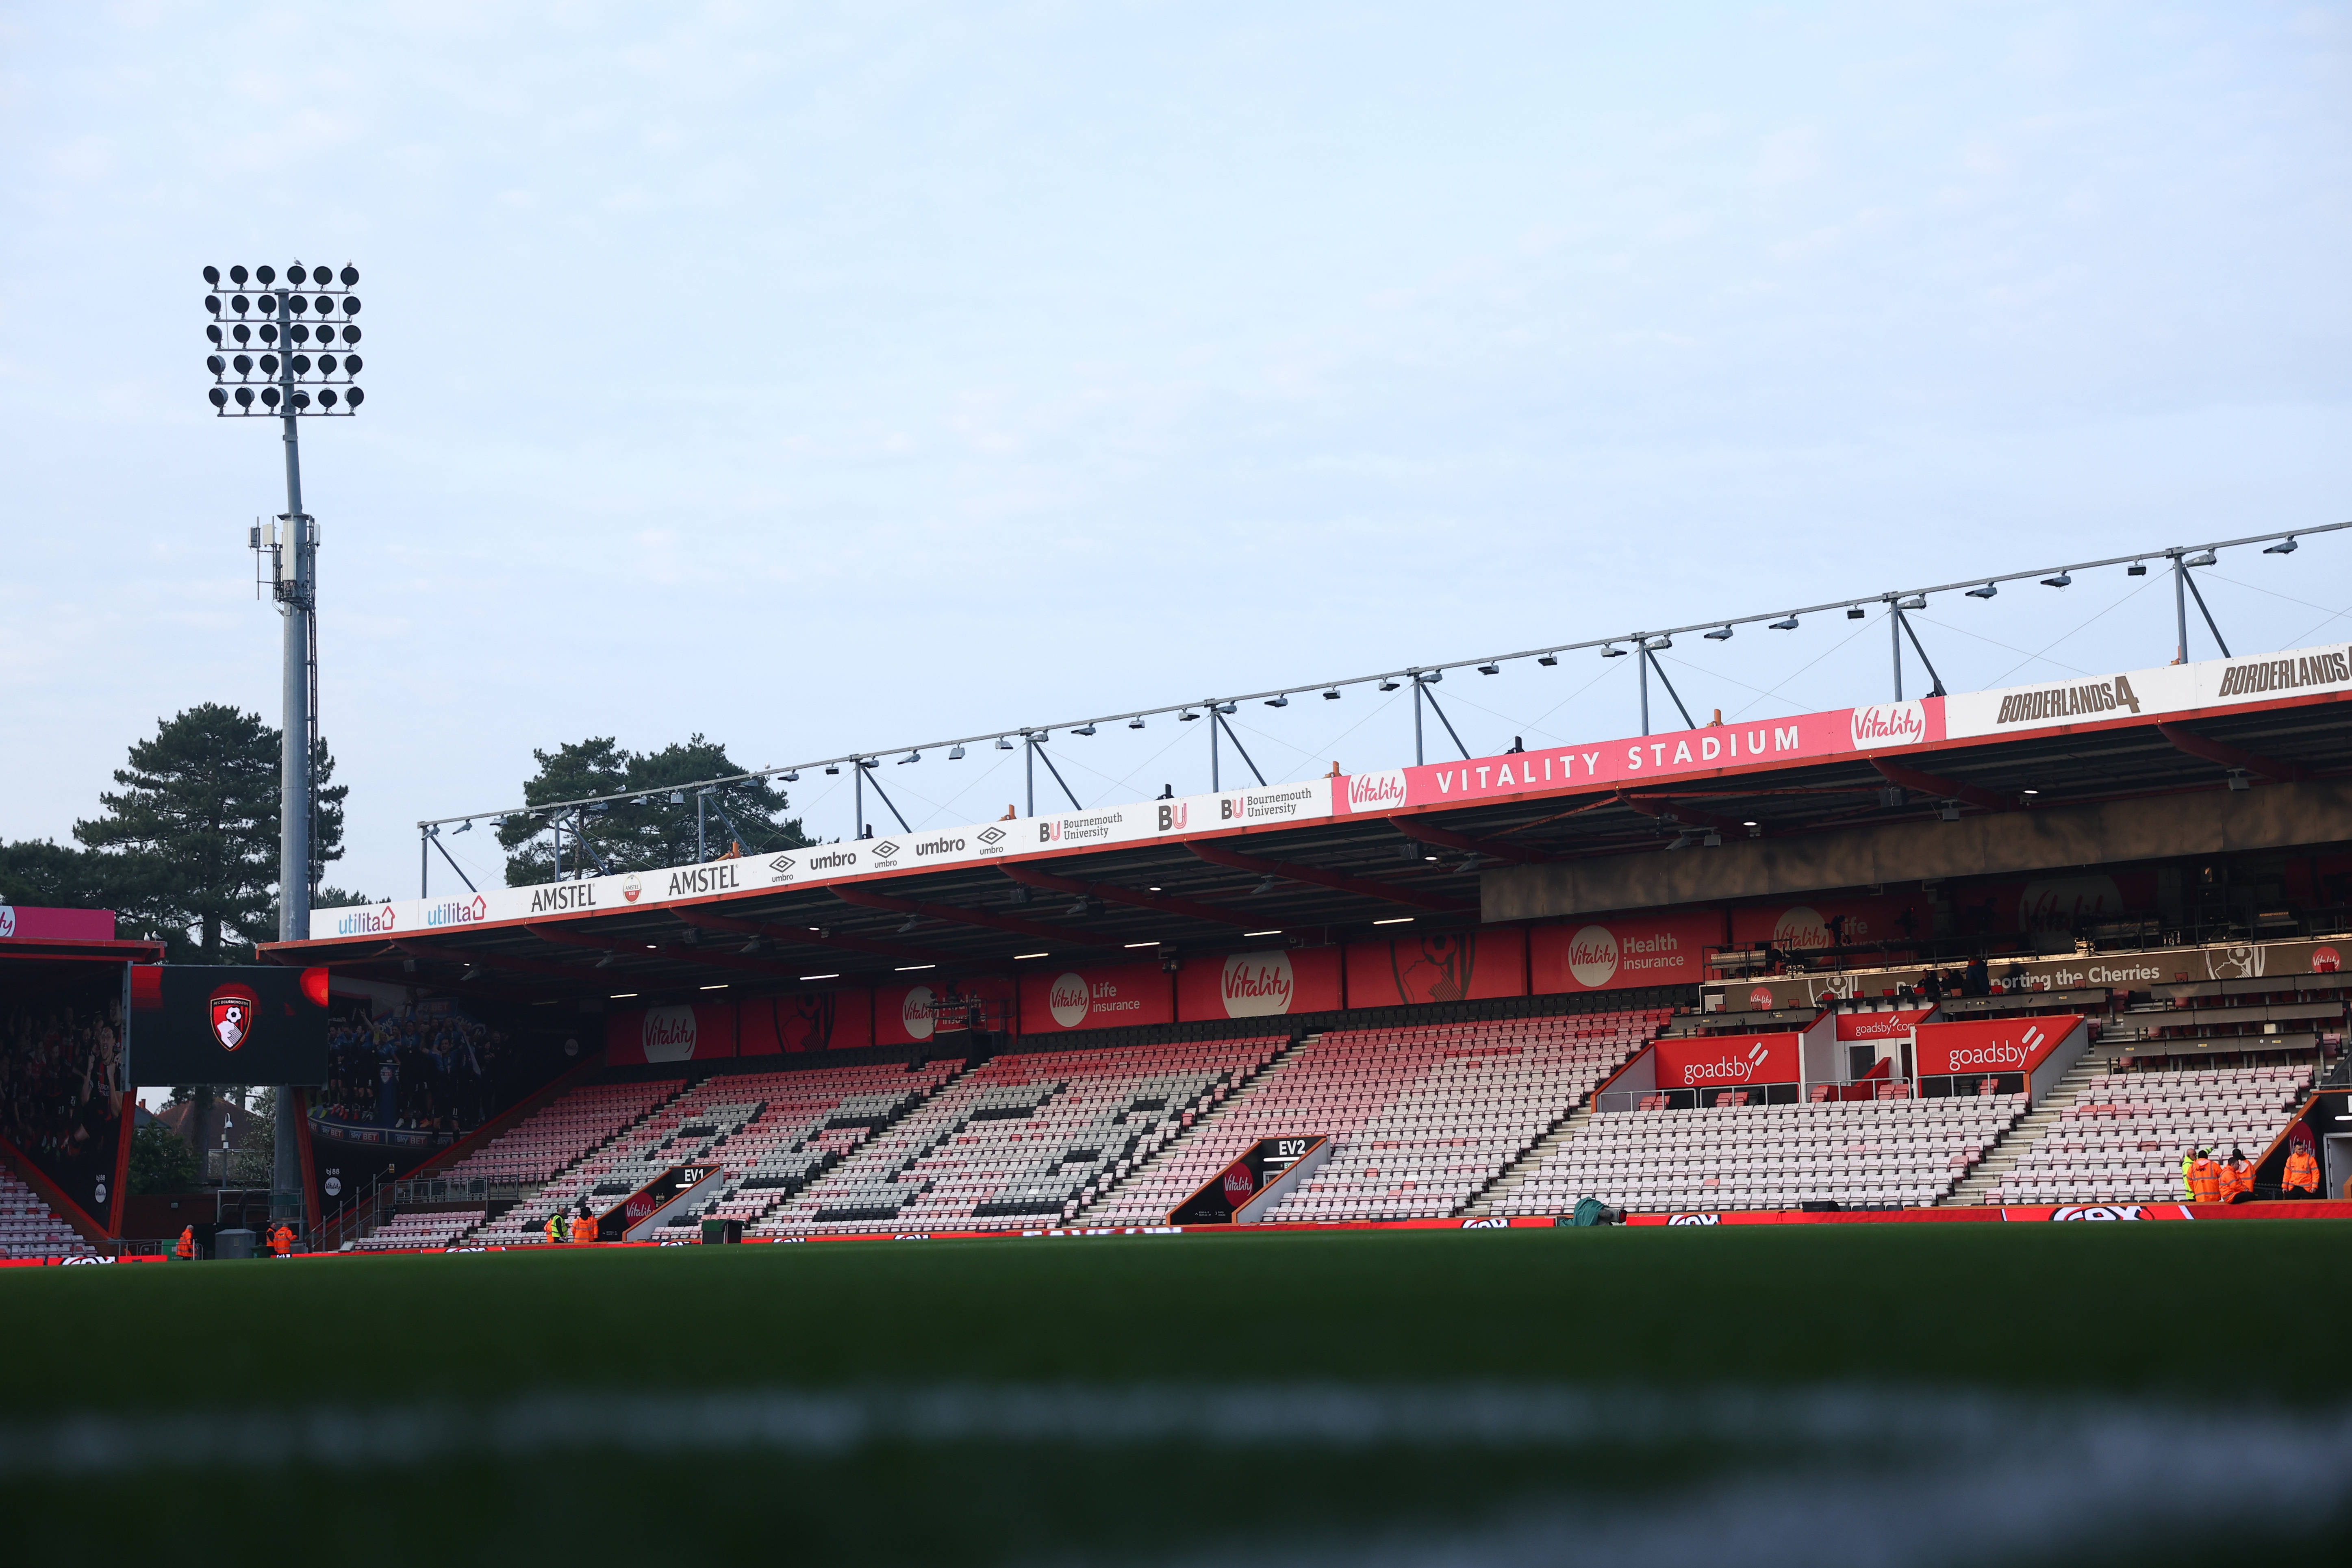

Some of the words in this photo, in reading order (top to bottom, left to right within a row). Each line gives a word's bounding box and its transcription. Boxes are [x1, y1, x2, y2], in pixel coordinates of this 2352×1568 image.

[2219, 653, 2350, 697] BORDERLANDS
[1997, 683, 2116, 724] BORDERLANDS
[2115, 676, 2141, 713] 4
[1855, 707, 1922, 743] Vitality
[1436, 751, 1599, 794] VITALITY
[1628, 725, 1798, 770] STADIUM
[1247, 788, 1312, 806] Bournemouth
[1351, 775, 1404, 808] Vitality
[1158, 803, 1187, 831] BU
[1221, 798, 1243, 820] BU
[1248, 802, 1296, 817] University
[1064, 812, 1123, 829] Bournemouth
[1040, 822, 1060, 842] BU
[1064, 826, 1109, 840] University
[916, 837, 965, 856] umbro
[979, 846, 1003, 855] umbro
[810, 851, 856, 870] umbro
[874, 860, 897, 869] umbro
[669, 865, 739, 896] AMSTEL
[772, 873, 793, 882] umbro
[532, 883, 596, 912] AMSTEL
[339, 912, 380, 934] utilita
[428, 900, 471, 925] utilita
[1844, 916, 1868, 934] ife
[1623, 933, 1677, 954] Health
[1571, 943, 1616, 971] Vitality
[1623, 955, 1684, 970] insurance
[2088, 963, 2160, 984] Cherries
[1092, 982, 1117, 998] Life
[1225, 962, 1291, 1007] Vitality
[1051, 986, 1088, 1013] Vitality
[1093, 999, 1140, 1013] insurance
[646, 1014, 695, 1053] Vitality
[1949, 1040, 2029, 1071] goadsby
[1684, 1051, 1755, 1085] goadsby
[362, 1131, 379, 1141] BET
[410, 1136, 426, 1145] BET
[1279, 1139, 1306, 1155] EV2
[326, 1168, 340, 1176] bj88
[684, 1168, 704, 1182] EV1
[1224, 1173, 1253, 1196] Vitality
